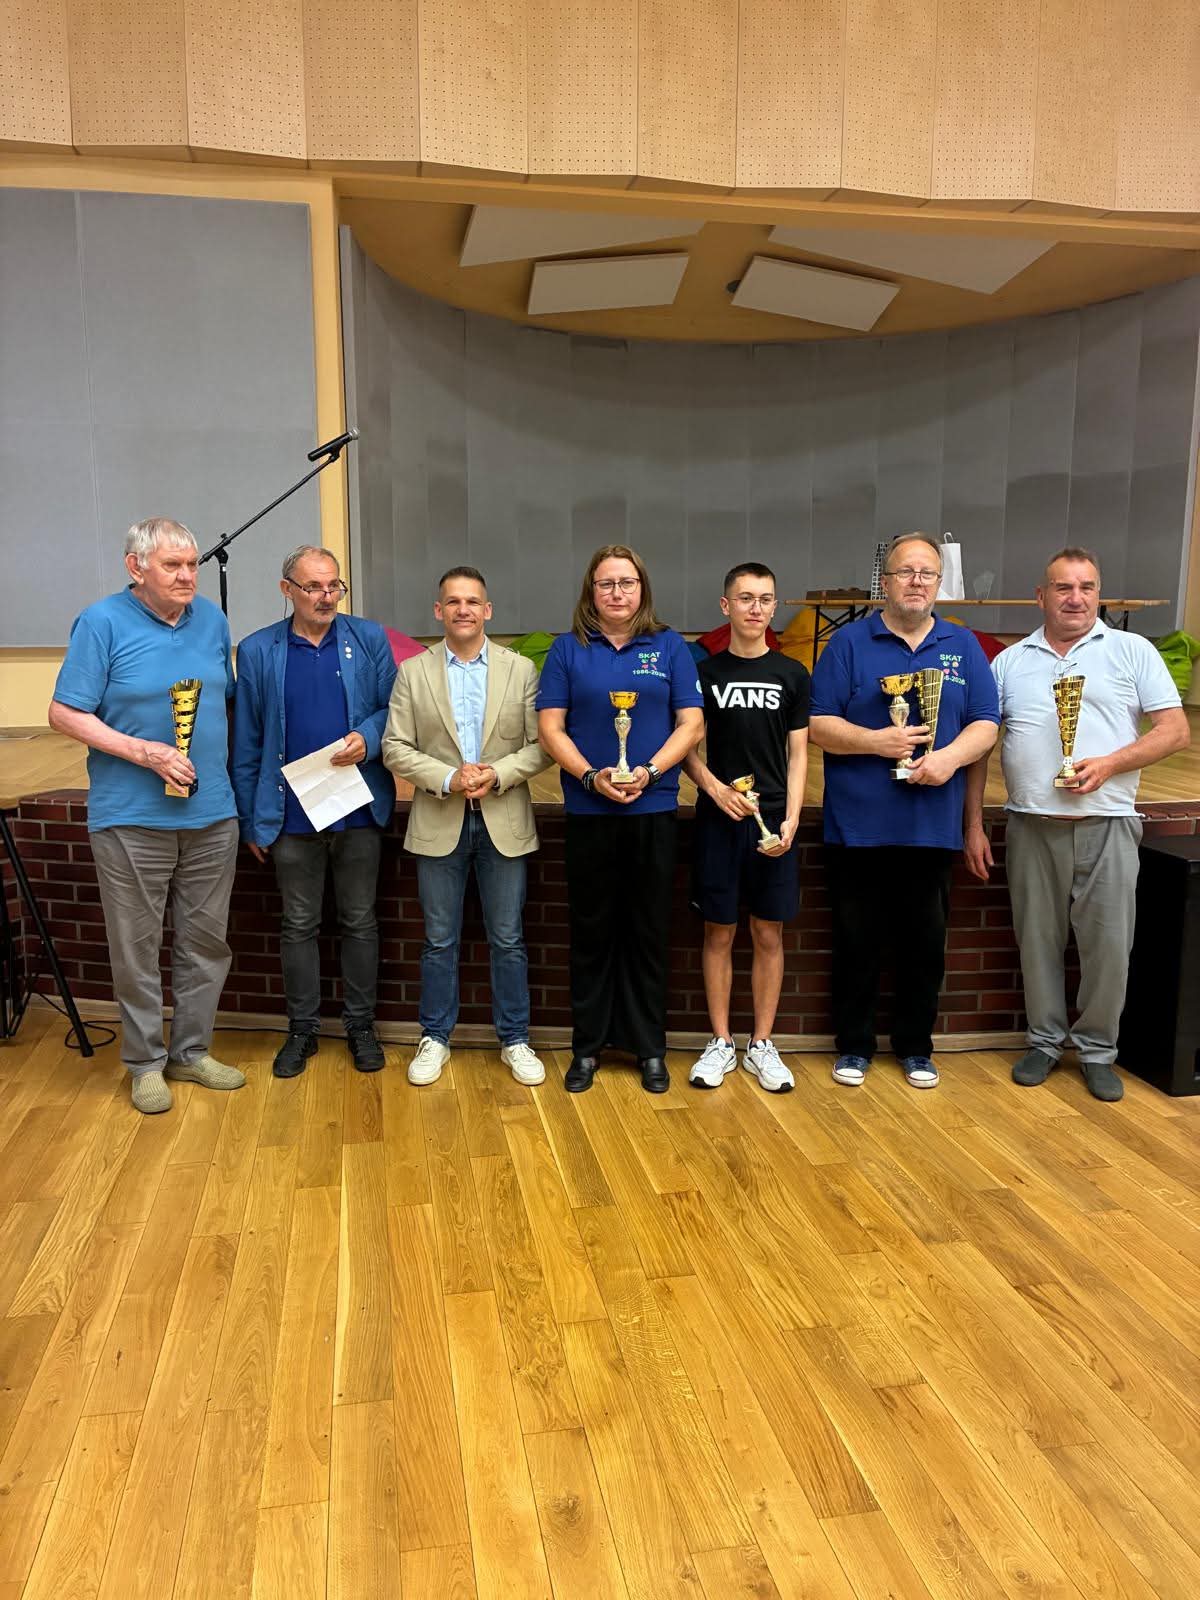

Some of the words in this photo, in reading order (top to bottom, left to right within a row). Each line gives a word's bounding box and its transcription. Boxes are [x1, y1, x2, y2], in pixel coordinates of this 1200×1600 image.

[638, 651, 661, 659] SKAT
[939, 653, 963, 662] SKAT
[711, 682, 782, 710] VANS
